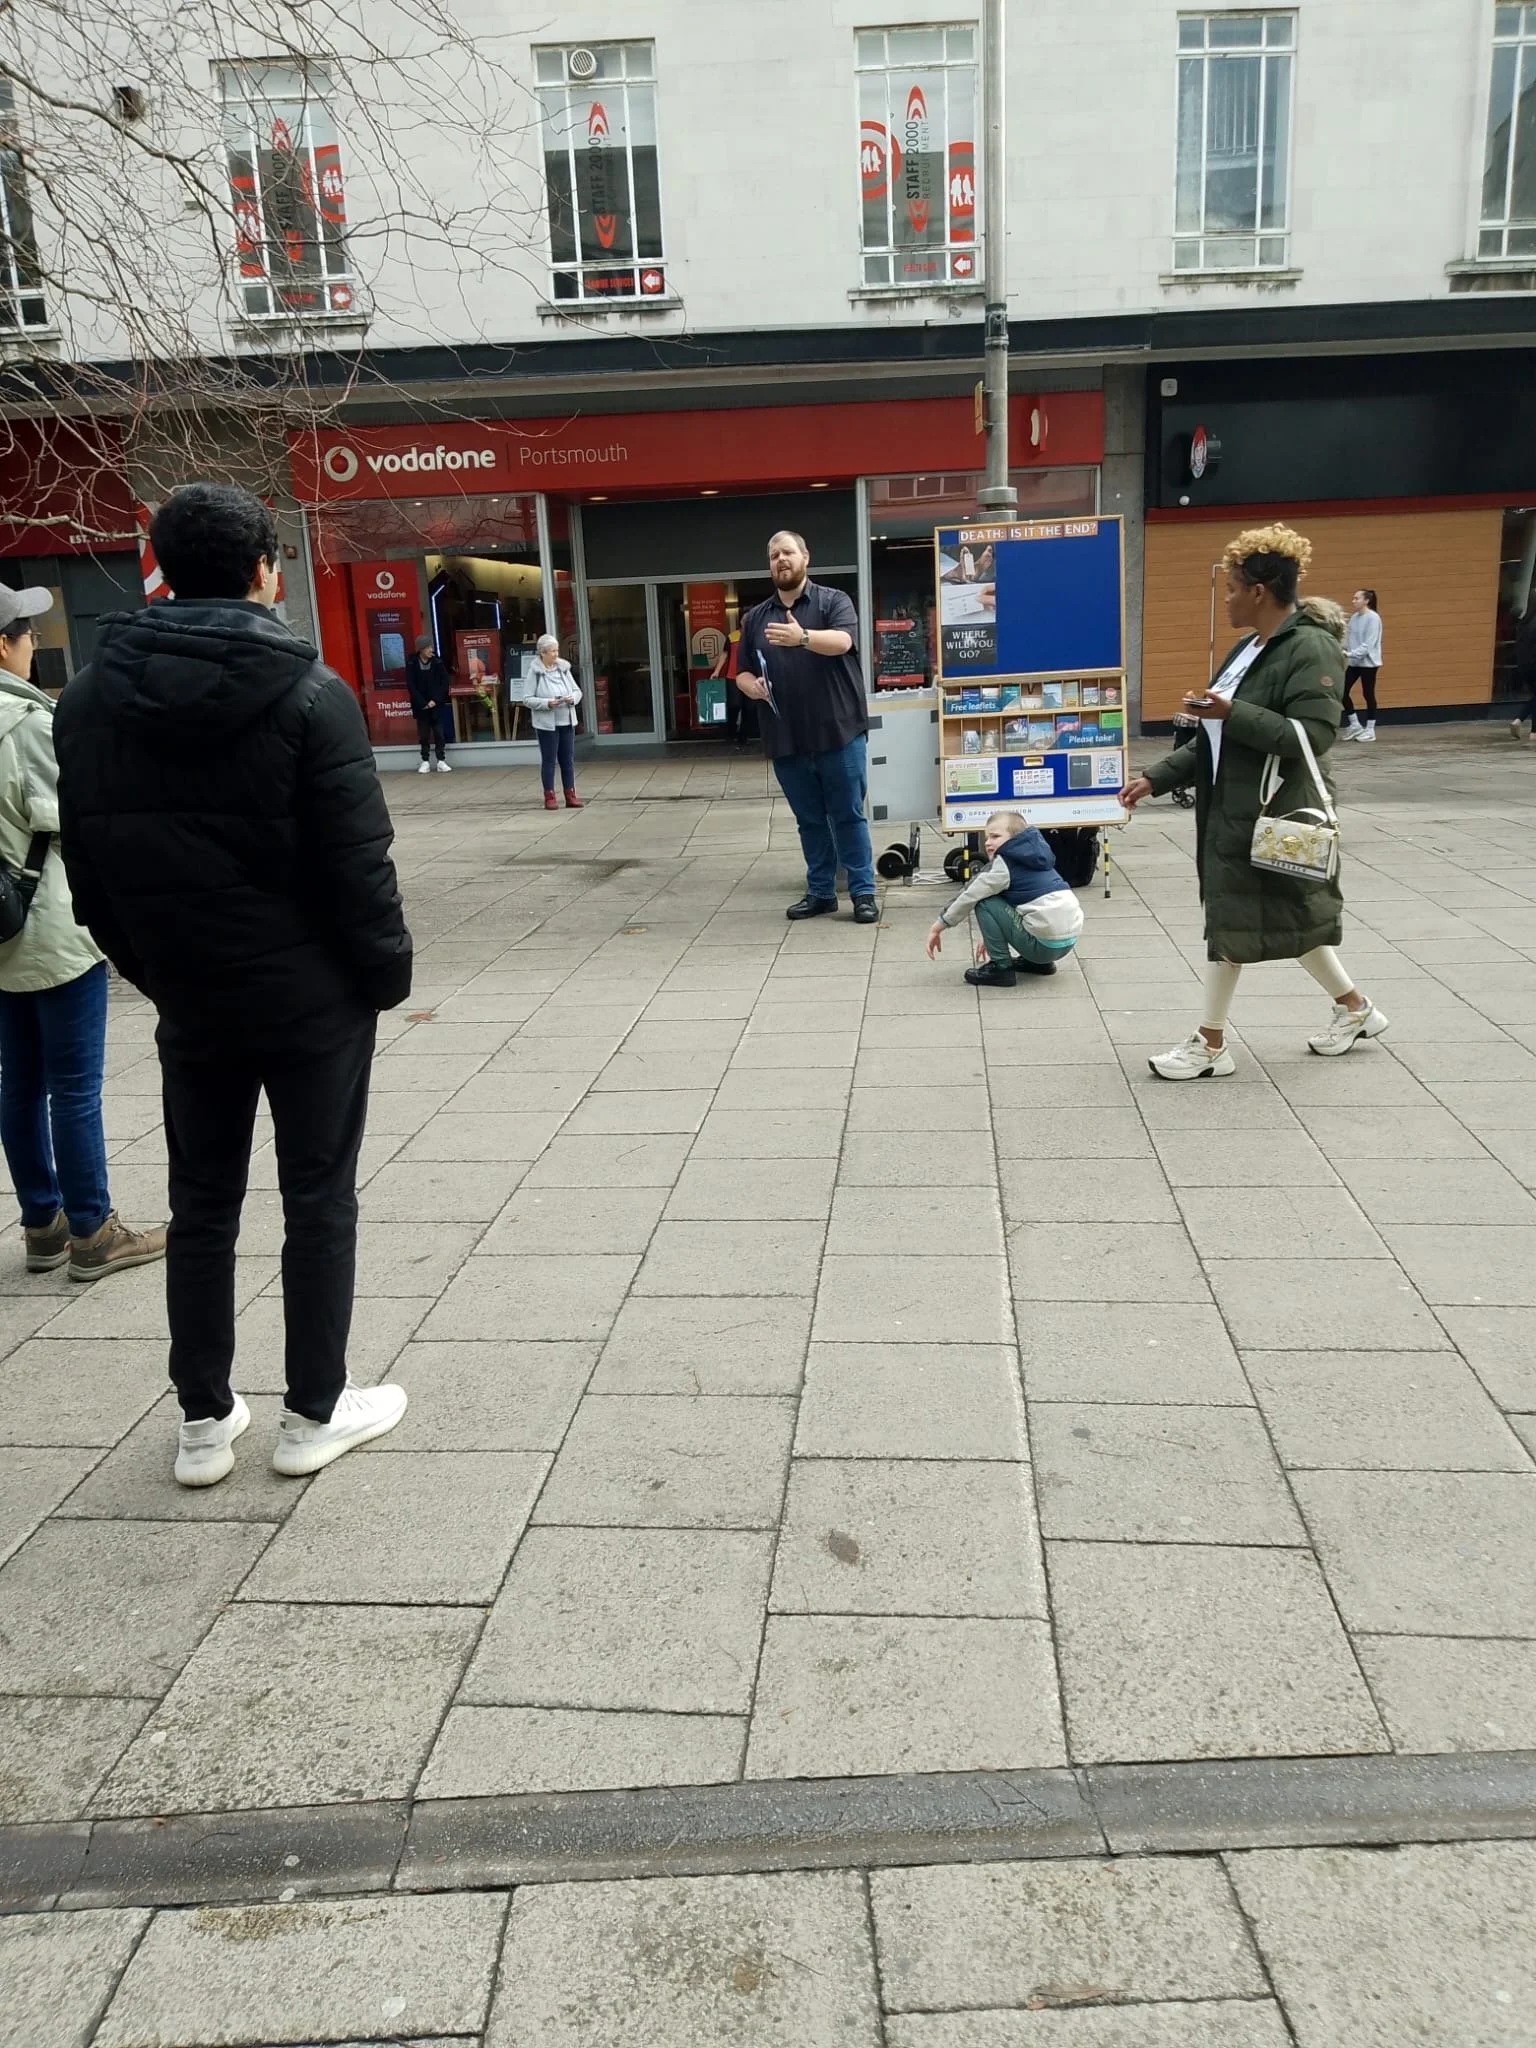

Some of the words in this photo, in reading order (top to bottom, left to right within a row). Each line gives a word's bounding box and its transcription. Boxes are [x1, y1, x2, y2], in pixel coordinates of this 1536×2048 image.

[905, 121, 919, 155] 2000
[587, 137, 603, 170] 2000
[905, 159, 920, 199] STAFF
[590, 175, 606, 214] STAFF
[366, 445, 496, 473] vodafone
[519, 443, 628, 466] Portsmouth
[960, 529, 1005, 541] DEATH:
[1010, 527, 1022, 538] IS
[1024, 527, 1035, 537] IT
[1039, 525, 1062, 536] THE
[1065, 522, 1097, 535] END?
[367, 591, 407, 599] vodafone
[952, 630, 988, 639] WHERE
[972, 639, 994, 648] YOU
[959, 650, 980, 659] GO?
[950, 702, 967, 712] Free
[968, 701, 996, 710] leaflets
[1068, 735, 1094, 744] Please
[1095, 733, 1116, 742] take!
